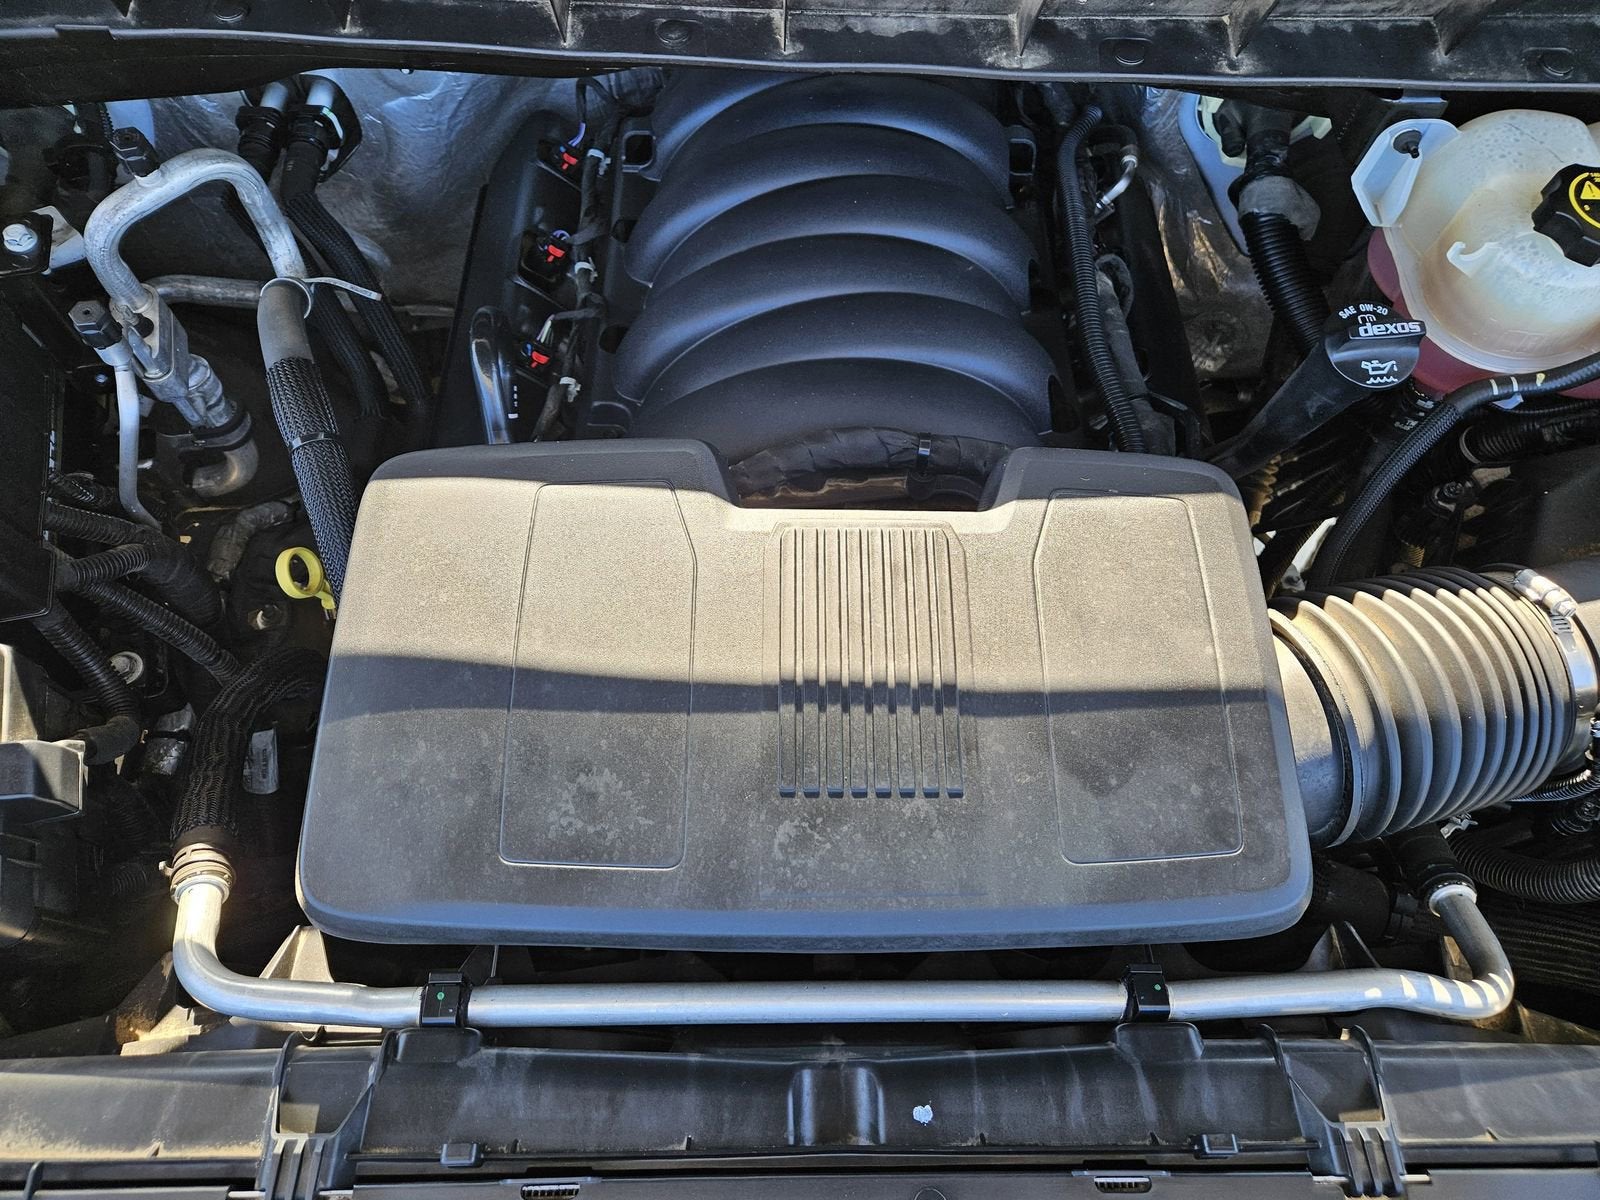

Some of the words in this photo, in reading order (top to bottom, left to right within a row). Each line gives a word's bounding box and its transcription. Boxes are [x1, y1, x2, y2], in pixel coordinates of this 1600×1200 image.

[1338, 305, 1357, 319] SAE
[1360, 303, 1388, 316] 0W-20
[1358, 321, 1421, 337] dexos
